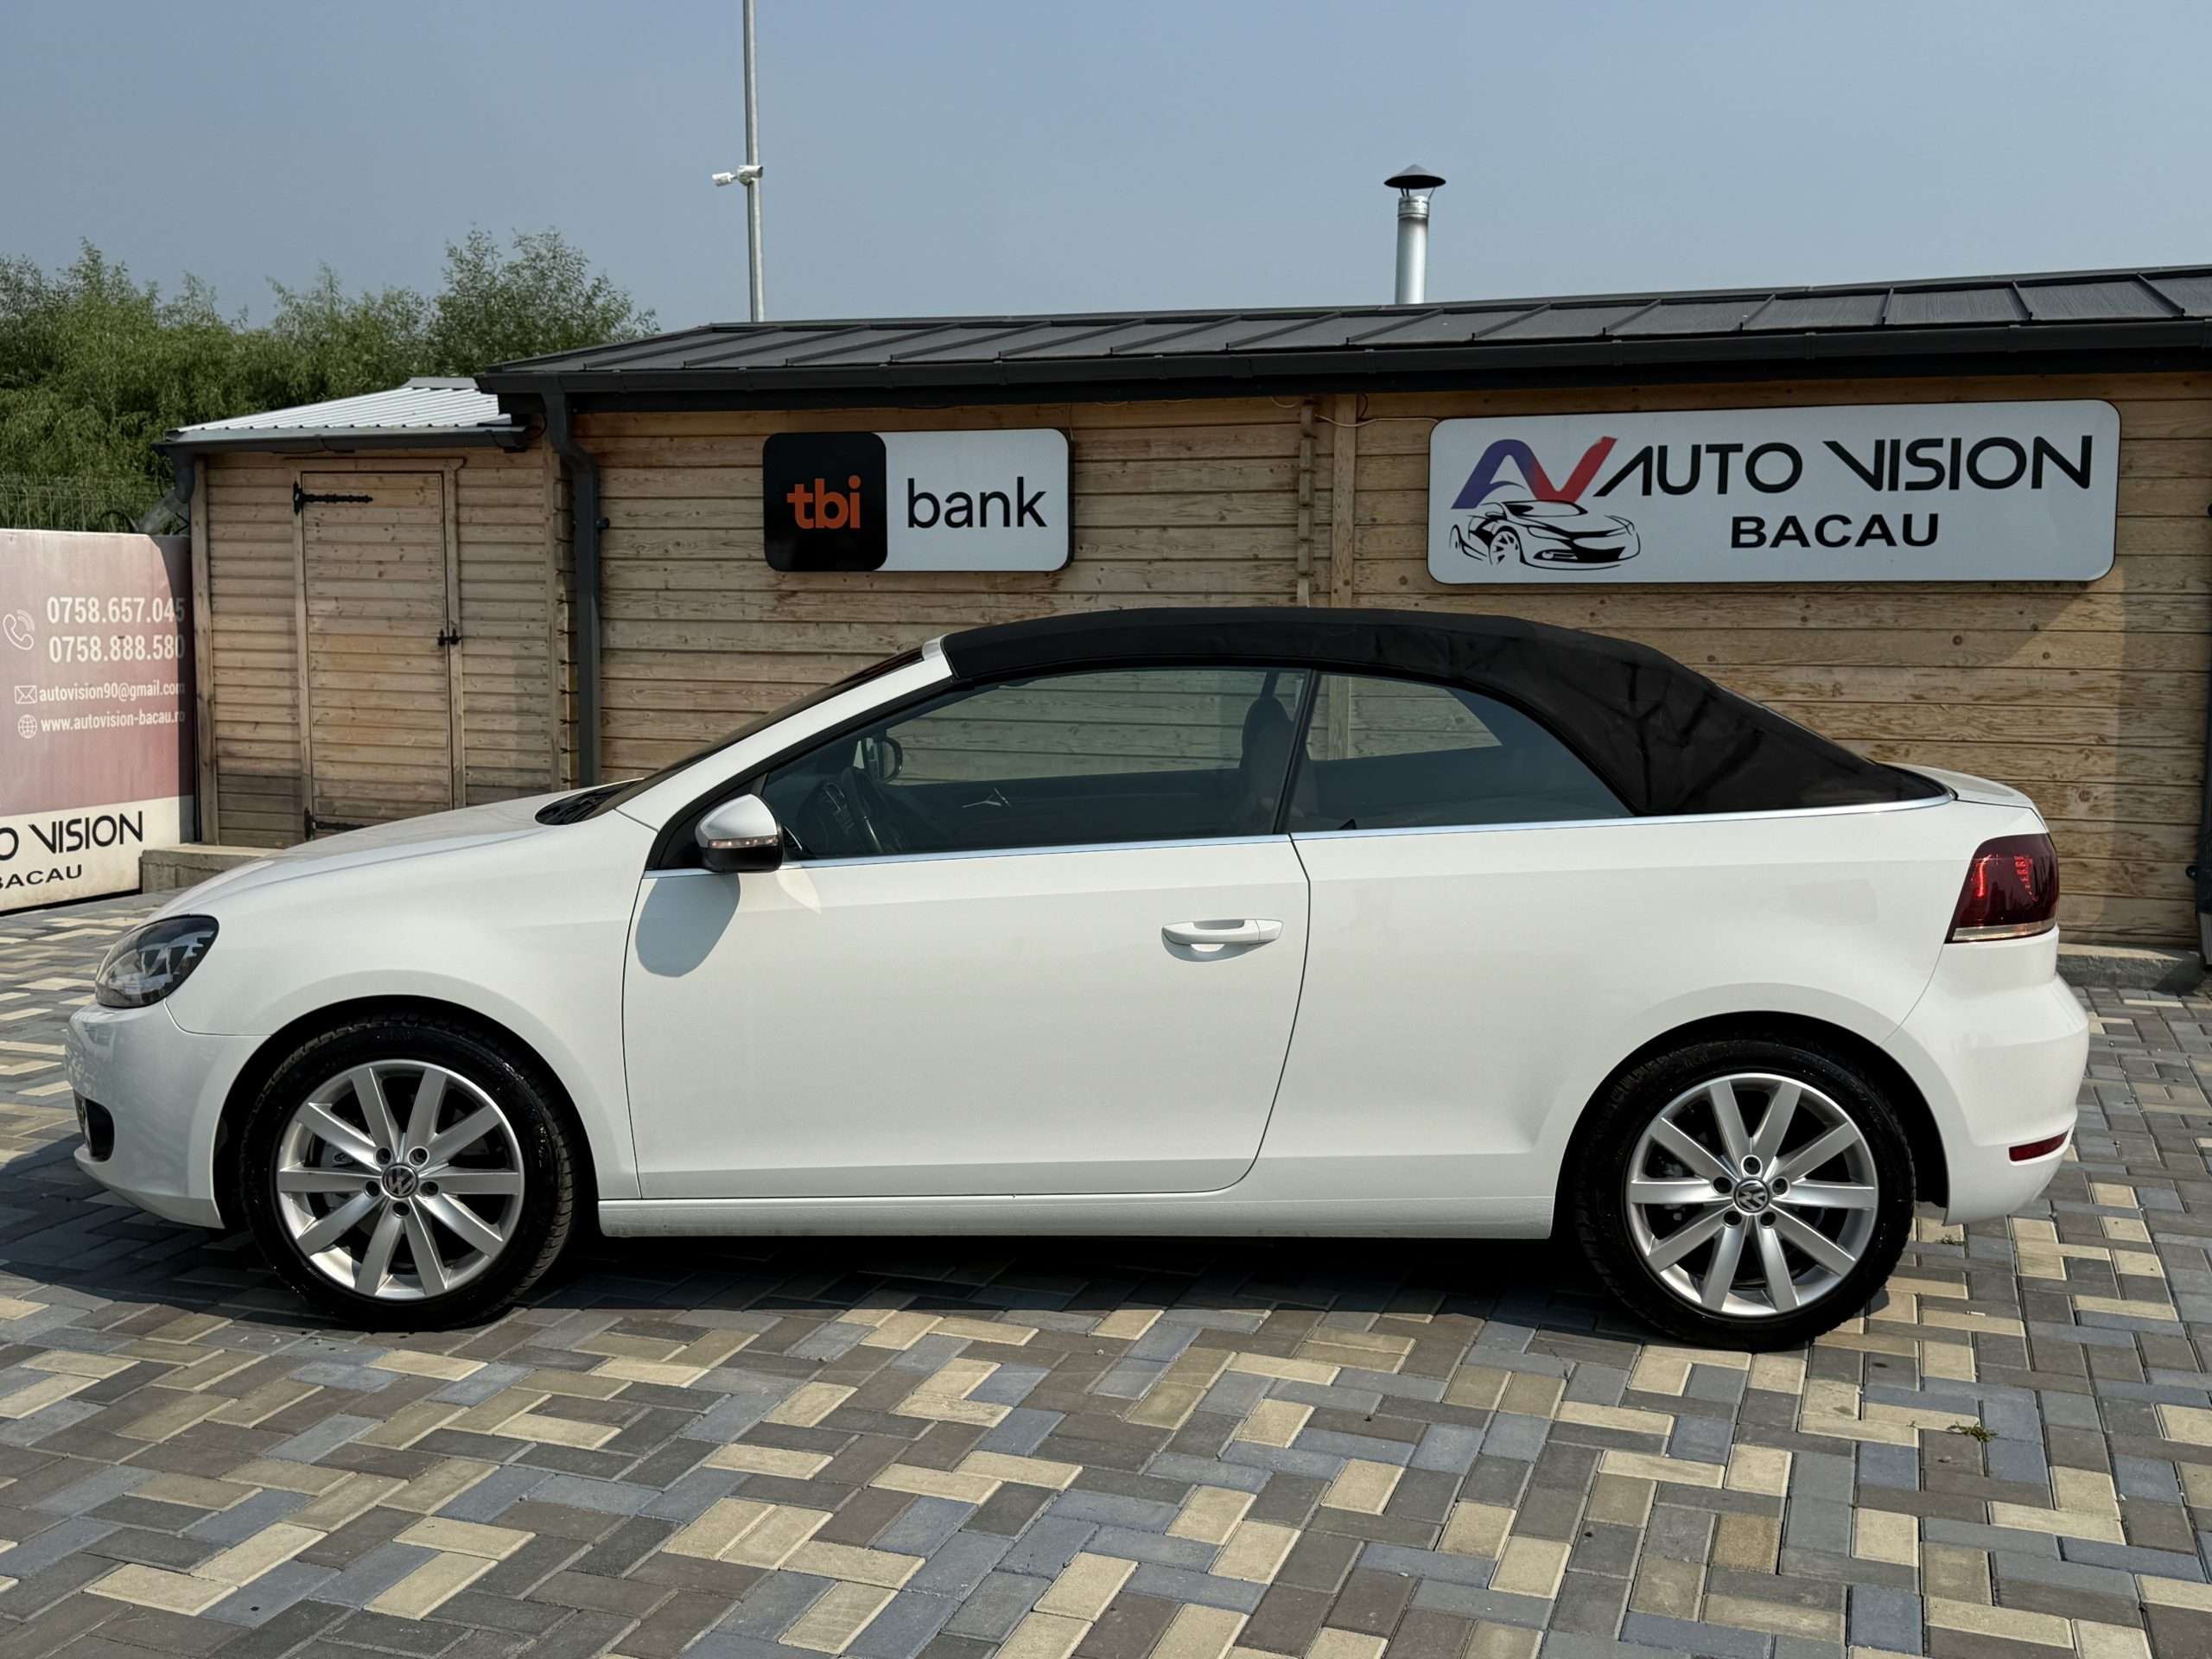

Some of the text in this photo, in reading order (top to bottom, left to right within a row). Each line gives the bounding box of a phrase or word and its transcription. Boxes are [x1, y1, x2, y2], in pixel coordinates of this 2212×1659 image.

[1592, 435, 2093, 497] AUTO VISION
[786, 475, 1048, 530] tbi bank
[1731, 513, 1938, 549] BACAU
[46, 596, 185, 624] 0758.657.045
[48, 634, 185, 663] 0758.888.580
[39, 679, 185, 702] autovision90@gmail.com
[41, 708, 185, 732] www.autovision-bacau.ro
[28, 810, 143, 854] VISION
[0, 864, 82, 888] ACAU
